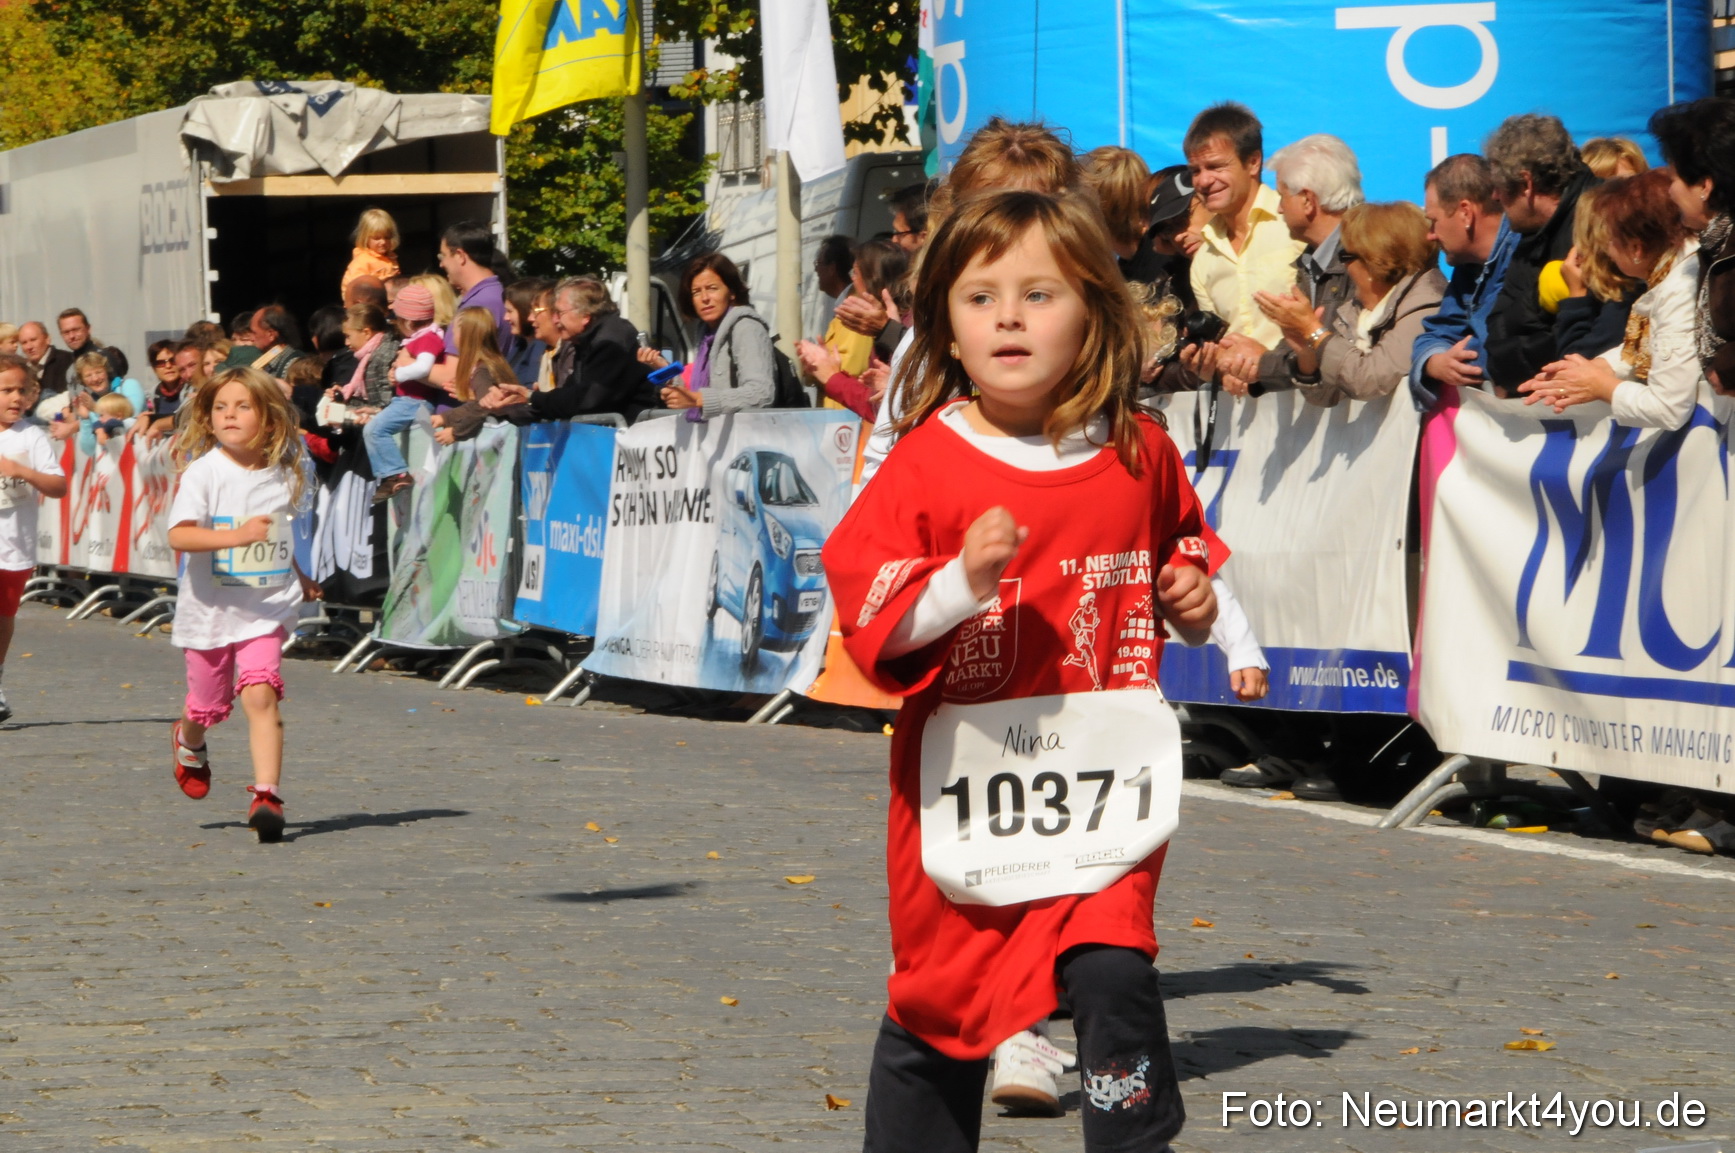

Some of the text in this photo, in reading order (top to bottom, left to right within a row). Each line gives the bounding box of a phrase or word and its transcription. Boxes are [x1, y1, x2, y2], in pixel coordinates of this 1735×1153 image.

[654, 444, 678, 480] SO
[241, 540, 289, 564] 7075
[1059, 558, 1083, 577] 11.
[1001, 723, 1066, 758] Nina
[1490, 705, 1732, 764] MICRO COMPUTER MANAGING
[940, 765, 1152, 842] 10371
[983, 860, 1051, 878] PFLEIDERER
